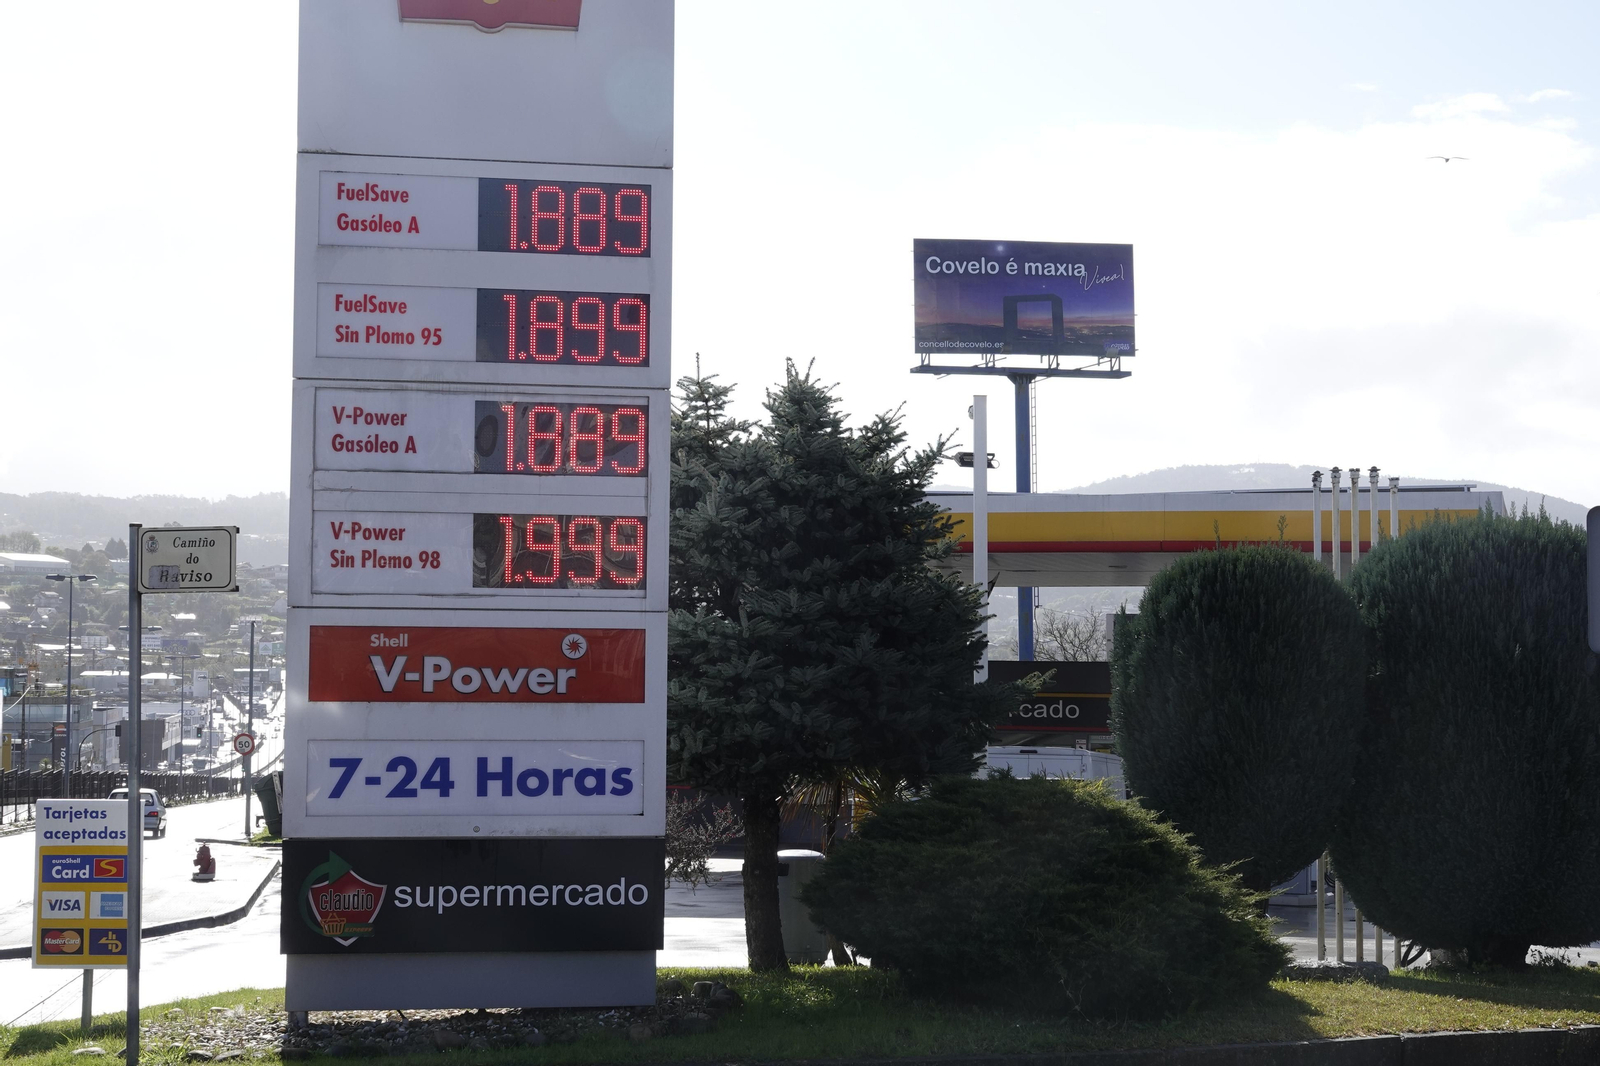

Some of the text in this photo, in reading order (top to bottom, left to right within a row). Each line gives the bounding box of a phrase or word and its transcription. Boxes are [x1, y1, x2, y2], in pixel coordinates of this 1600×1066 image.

[337, 182, 409, 203] FuelSave
[337, 213, 420, 234] Gasóleo A
[505, 184, 648, 253] 1.889
[925, 256, 1000, 274] Covelo
[1006, 258, 1018, 275] é
[335, 294, 407, 314] FuelSave
[335, 325, 443, 346] Sin Plomo 95
[503, 294, 647, 364] 1.899
[332, 406, 407, 426] V-Power
[331, 434, 417, 454] Gasóleo A
[501, 405, 646, 474] 1.889
[330, 522, 406, 541] V-Power
[173, 537, 215, 548] Camiño
[500, 516, 644, 584] 1.999
[186, 553, 199, 564] do
[330, 550, 441, 569] Sin Plomo 98
[160, 570, 212, 582] Raviso
[370, 634, 408, 648] Shell
[369, 655, 577, 695] V-Power
[1009, 700, 1080, 719] cado
[238, 740, 250, 748] 50
[328, 756, 634, 799] 7-24 Horas
[43, 806, 107, 823] Tarjetas
[43, 826, 127, 843] aceptadas
[52, 865, 90, 879] Card
[46, 899, 81, 911] VISA
[320, 889, 374, 911] claudio
[394, 877, 649, 914] supermercado
[44, 937, 81, 945] MasterCard
